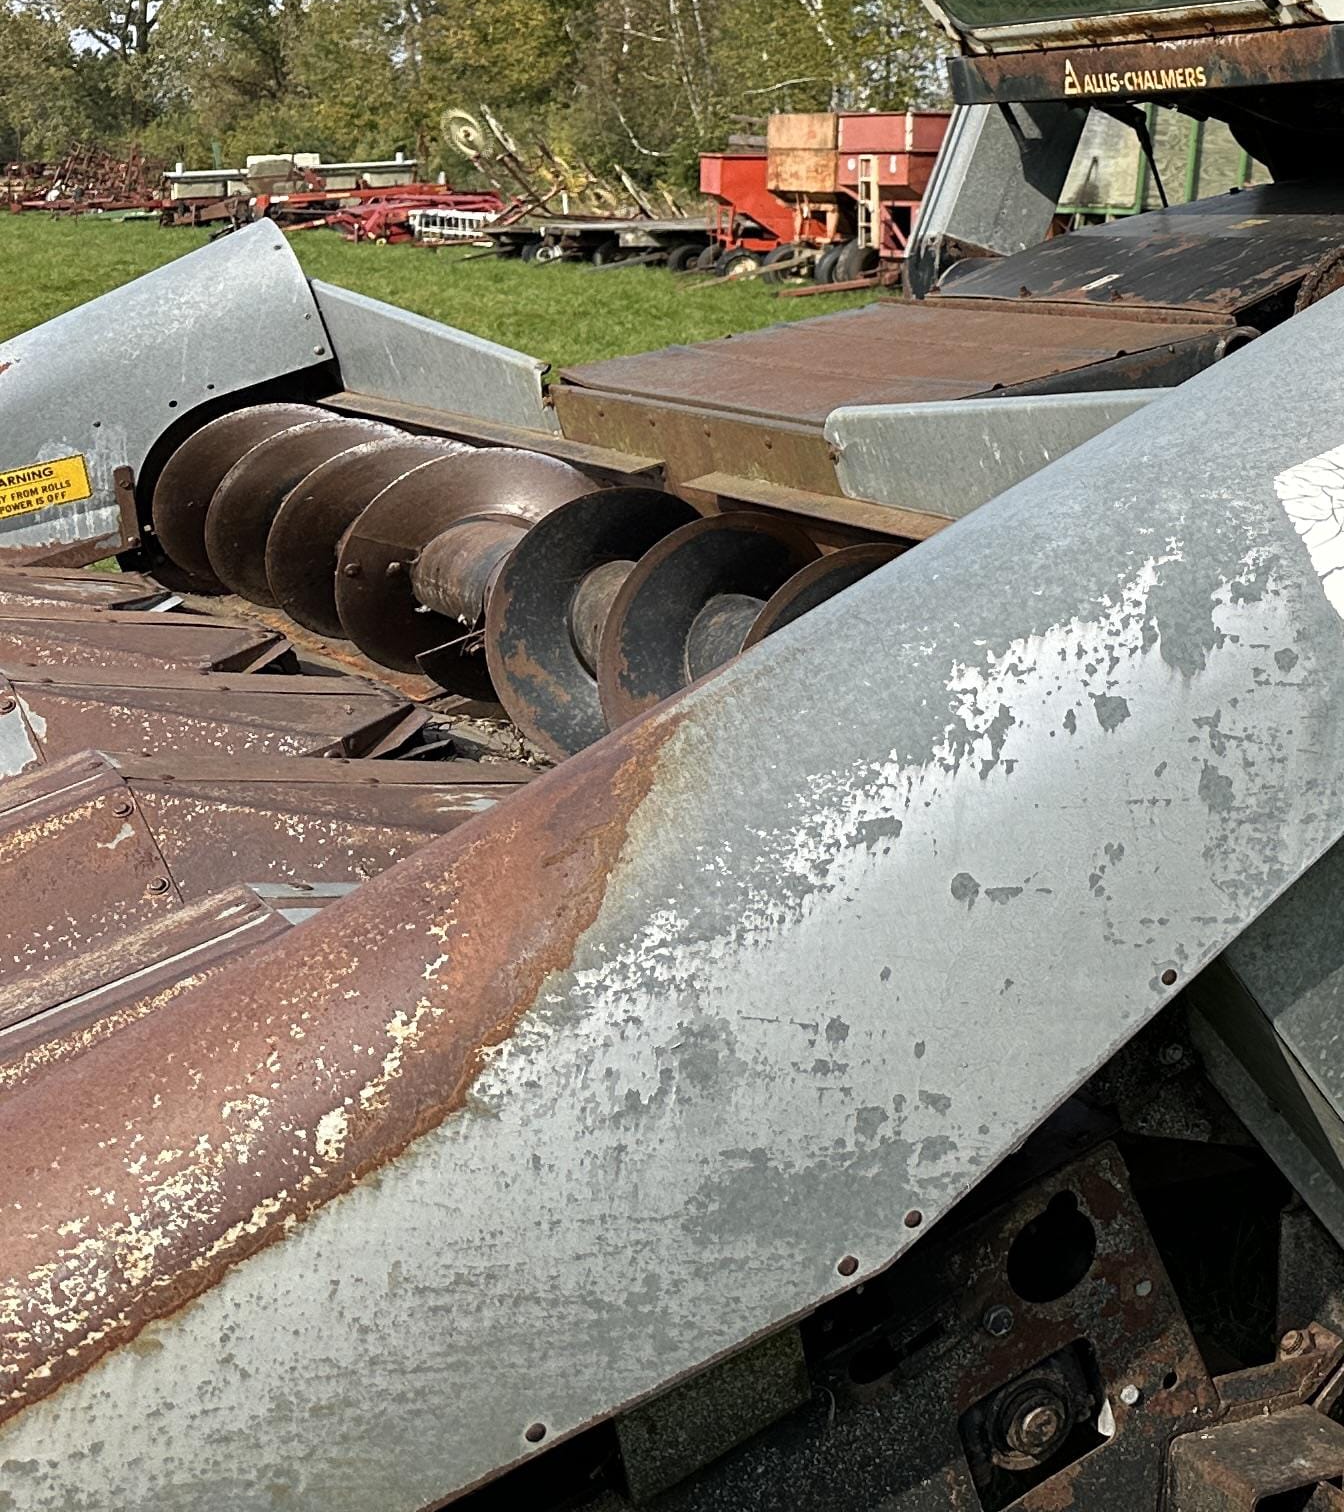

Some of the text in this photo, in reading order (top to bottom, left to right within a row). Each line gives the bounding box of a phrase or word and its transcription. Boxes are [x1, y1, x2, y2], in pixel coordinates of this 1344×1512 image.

[1083, 66, 1207, 93] ALLIS-CHALMERS
[11, 487, 39, 501] FROM
[41, 479, 72, 494] ROLLS
[36, 496, 45, 506] IS
[47, 490, 67, 503] OFF
